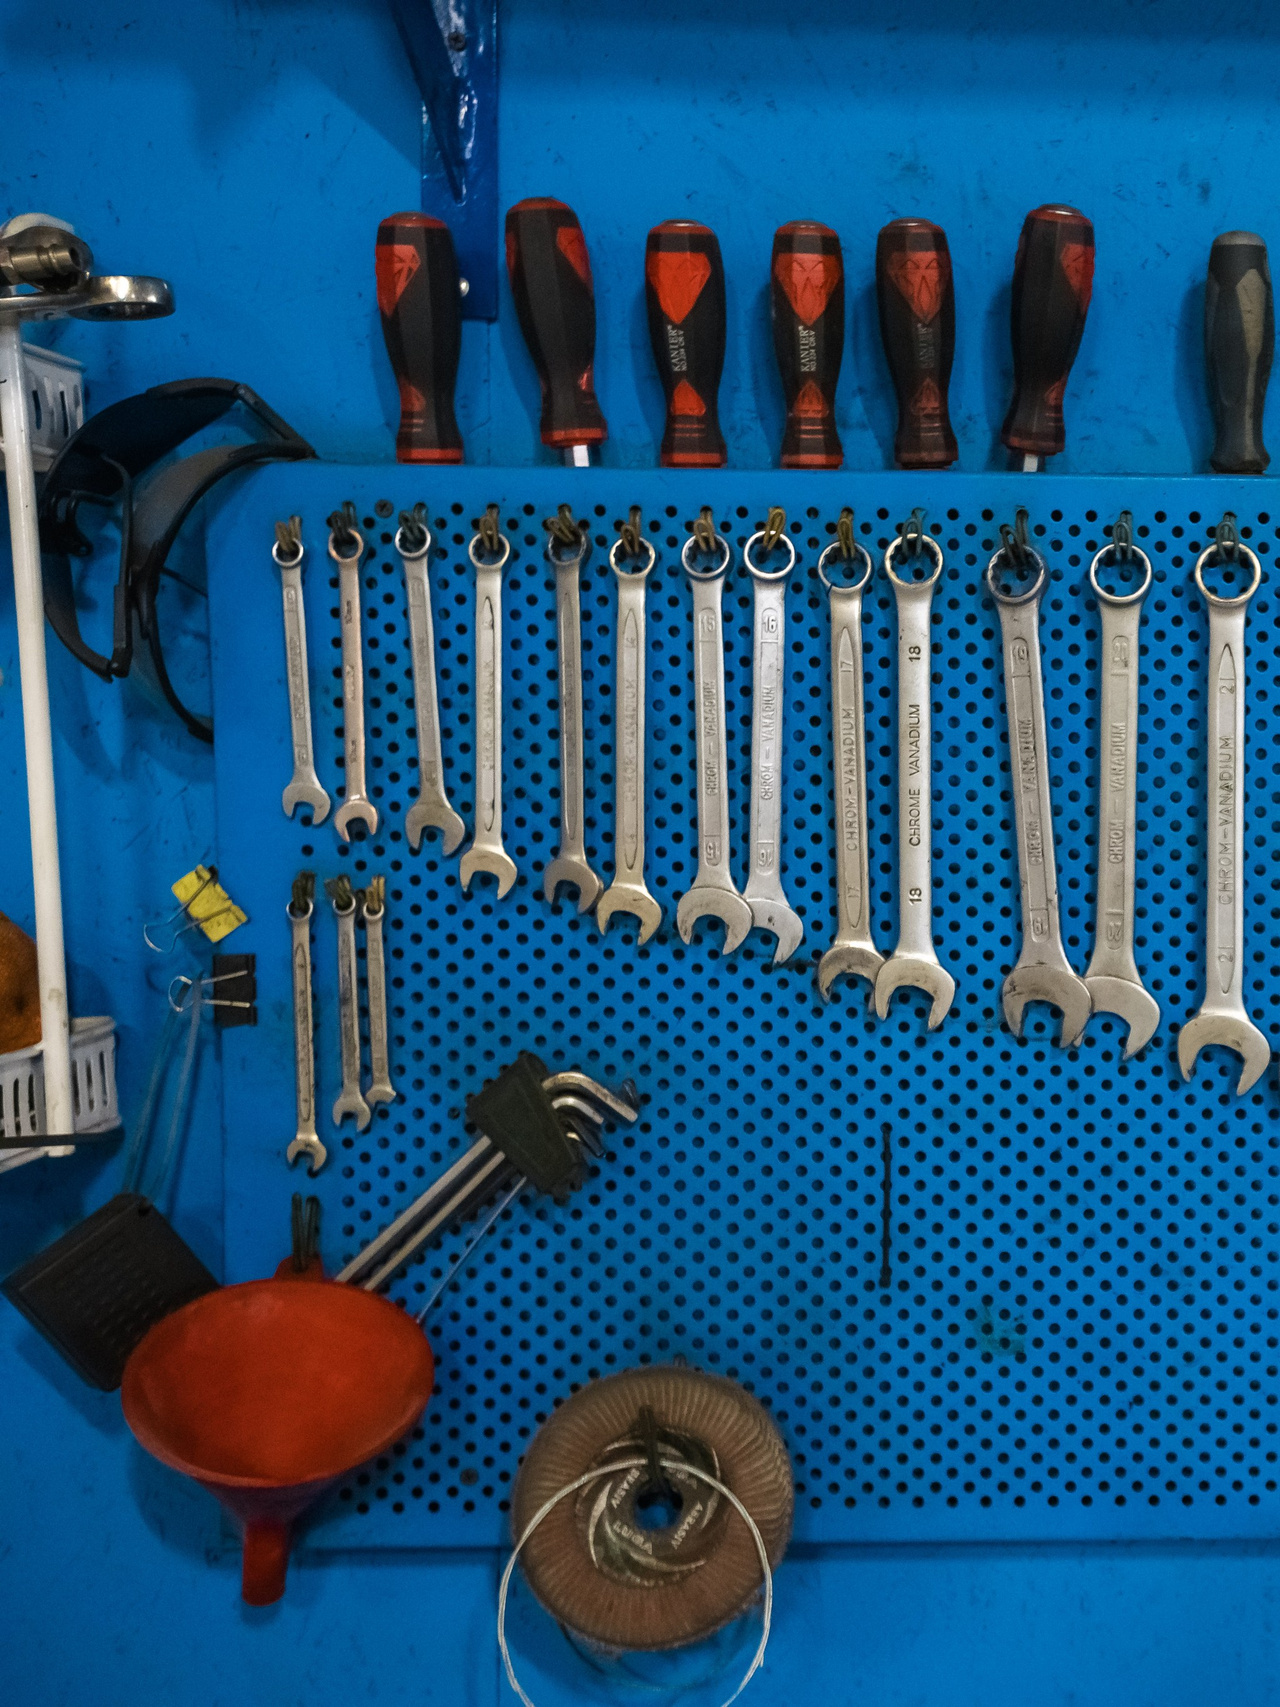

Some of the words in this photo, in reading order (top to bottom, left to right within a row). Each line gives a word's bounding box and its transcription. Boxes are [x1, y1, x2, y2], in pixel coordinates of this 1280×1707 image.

[908, 646, 921, 663] 18
[1220, 677, 1235, 695] 21
[908, 704, 921, 776] VANADIUM
[908, 789, 921, 847] CHROME
[909, 887, 922, 905] 18
[1218, 946, 1233, 963] 21
